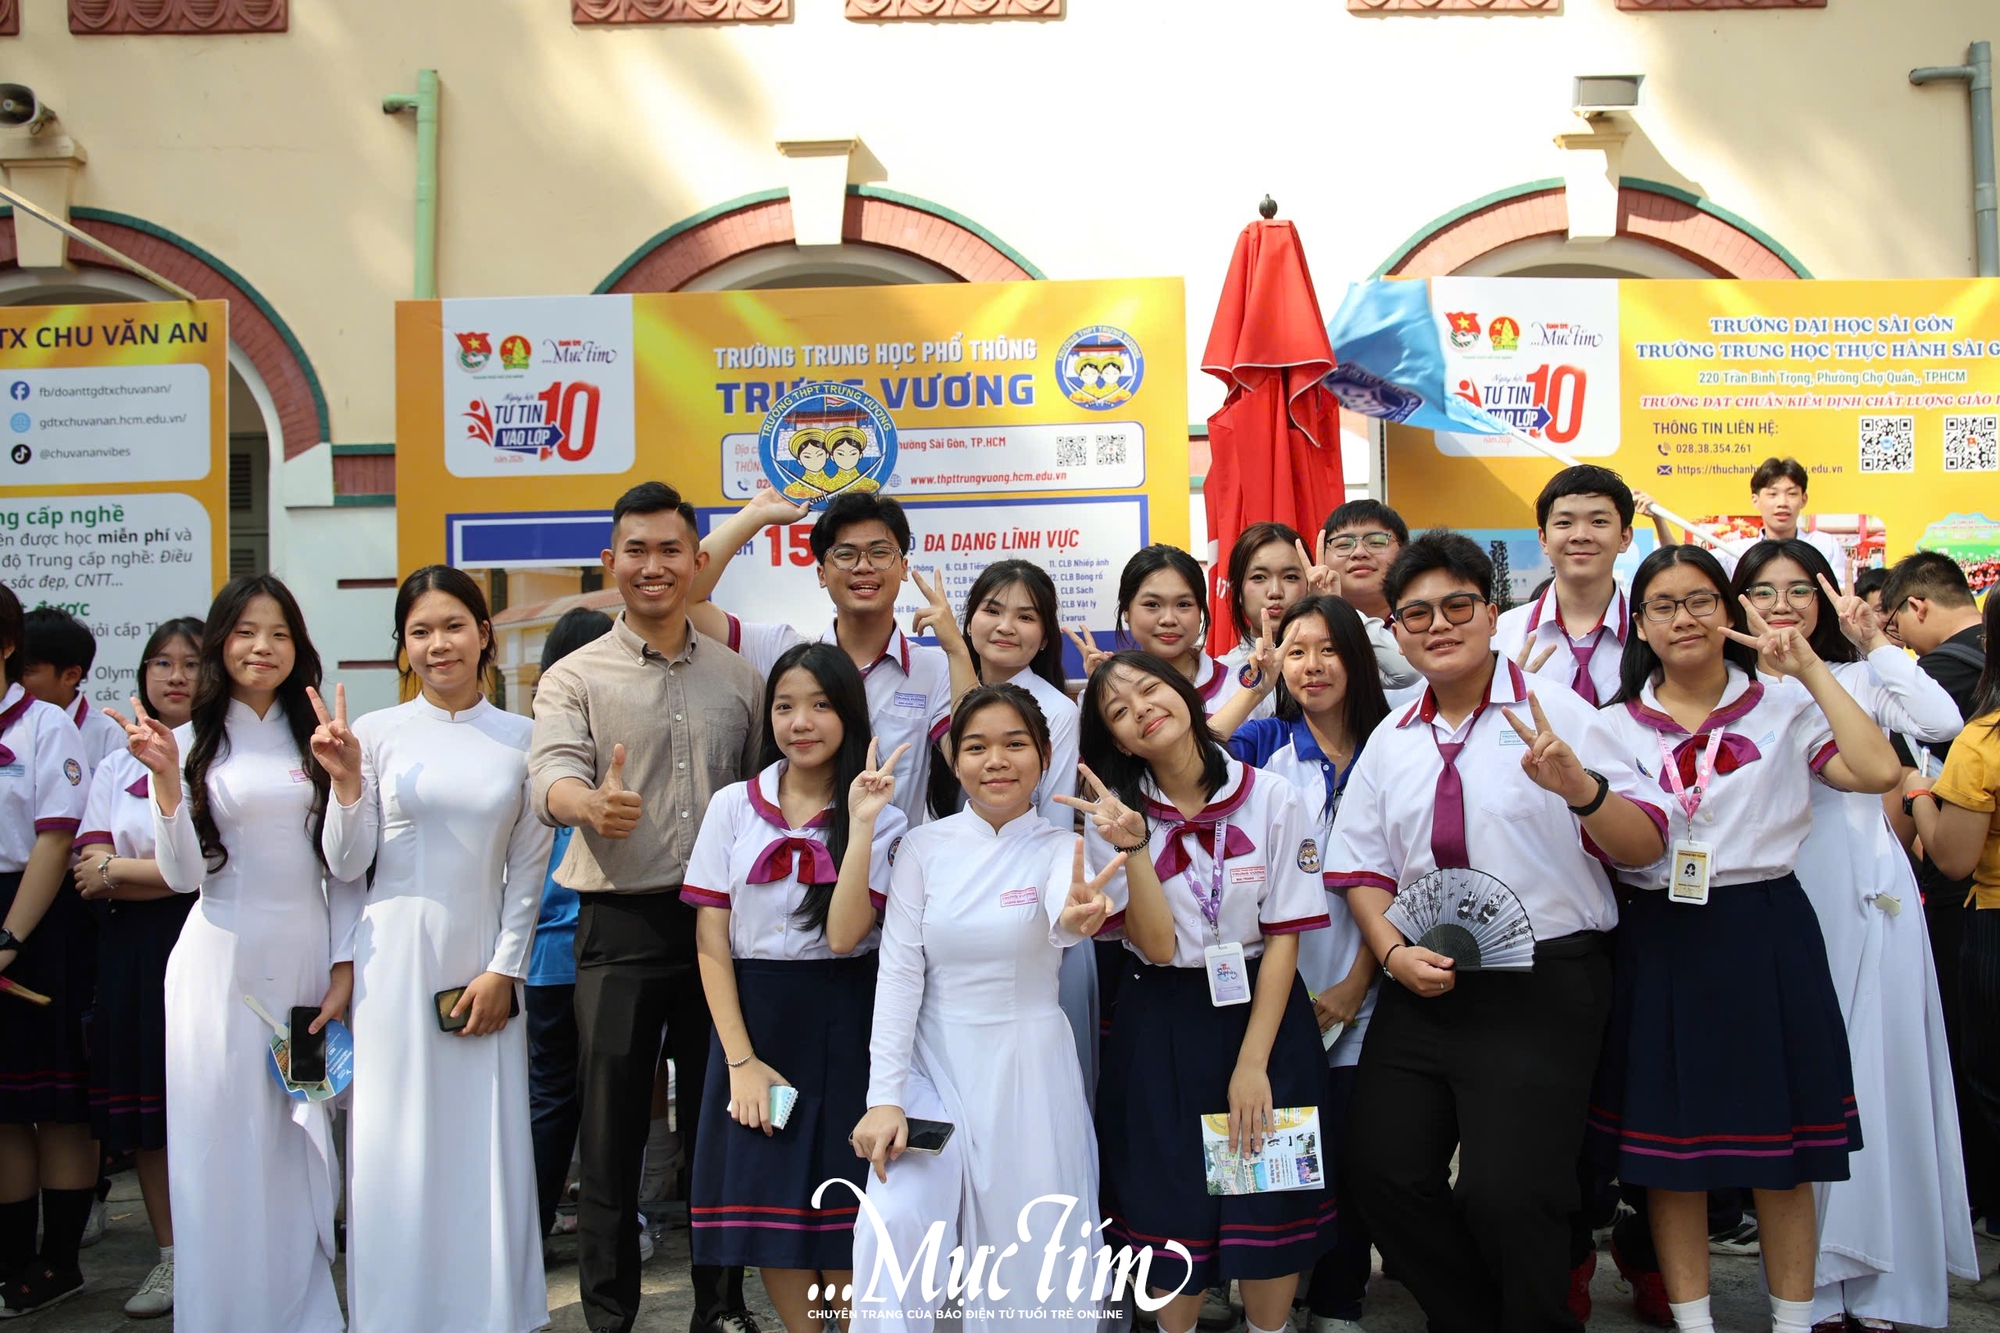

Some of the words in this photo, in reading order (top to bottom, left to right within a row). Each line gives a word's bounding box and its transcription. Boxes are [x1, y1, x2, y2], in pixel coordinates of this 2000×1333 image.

[36, 326, 92, 347] CHU
[103, 318, 159, 346] VĂN
[168, 322, 207, 343] AN
[1711, 316, 1788, 333] TRƯỜNG
[1795, 319, 1827, 336] ĐẠI
[1834, 319, 1873, 336] HỌC
[1878, 315, 1909, 332] SÀI
[1914, 315, 1954, 332] GÒN
[714, 342, 795, 369] TRƯỜNG
[801, 344, 869, 366] TRUNG
[875, 341, 916, 370] HỌC
[922, 331, 963, 363] PHỔ
[969, 334, 1037, 361] THÔNG
[1636, 341, 1714, 358] TRƯỜNG
[1720, 344, 1784, 358] TRUNG
[1790, 344, 1830, 361] HỌC
[1834, 343, 1886, 360] THỰC
[1892, 340, 1946, 357] HÀNH
[1952, 339, 1983, 356] SÀI
[1699, 372, 1720, 384] 220
[1751, 372, 1775, 383] Bình
[1862, 371, 1883, 385] Chợ
[1925, 371, 1966, 382] TPHCM
[880, 372, 1034, 409] VƯƠNG
[1507, 386, 1531, 405] TIN
[1526, 364, 1587, 444] 10
[1641, 394, 1699, 407] TRƯỜNG
[518, 404, 543, 424] TIN
[761, 397, 793, 437] TRƯỜNG
[793, 385, 820, 400] THPT
[823, 384, 862, 400] TRƯNG
[863, 397, 892, 431] VƯƠNG
[39, 413, 187, 430] gdtxchuvanan.hcm.edu.vn/
[538, 380, 600, 462] 10
[1653, 420, 1697, 434] THÔNG
[1702, 422, 1723, 434] TIN
[1726, 420, 1754, 434] LIÊN
[1758, 420, 1779, 436] HỆ:
[929, 438, 944, 449] Sài
[971, 437, 1006, 448] TP.HCM
[1676, 444, 1751, 453] 028.38.354.261
[40, 447, 131, 460] @chuvananvibes
[736, 459, 763, 472] THÔN
[910, 471, 1067, 486] www.thpttrungvuong.hcm.edu.vn
[26, 505, 63, 529] cấp
[70, 503, 124, 528] nghề
[20, 532, 59, 548] được
[65, 531, 92, 547] học
[98, 527, 138, 543] miễn
[144, 528, 170, 546] phí
[174, 527, 192, 541] và
[924, 534, 945, 552] ĐA
[951, 532, 997, 556] DẠNG
[1001, 527, 1041, 549] LĨNH
[1047, 528, 1079, 553] VỰC
[2, 554, 21, 570] độ
[27, 554, 73, 570] Trung
[79, 551, 105, 568] cấp
[111, 549, 154, 568] nghề:
[160, 549, 192, 563] Điều
[11, 574, 35, 589] sắc
[39, 575, 68, 591] đẹp,
[75, 573, 123, 587] CNTT...
[1060, 573, 1074, 581] CLB
[91, 622, 110, 637] iỏi
[114, 621, 140, 639] cấp
[95, 687, 121, 701] các
